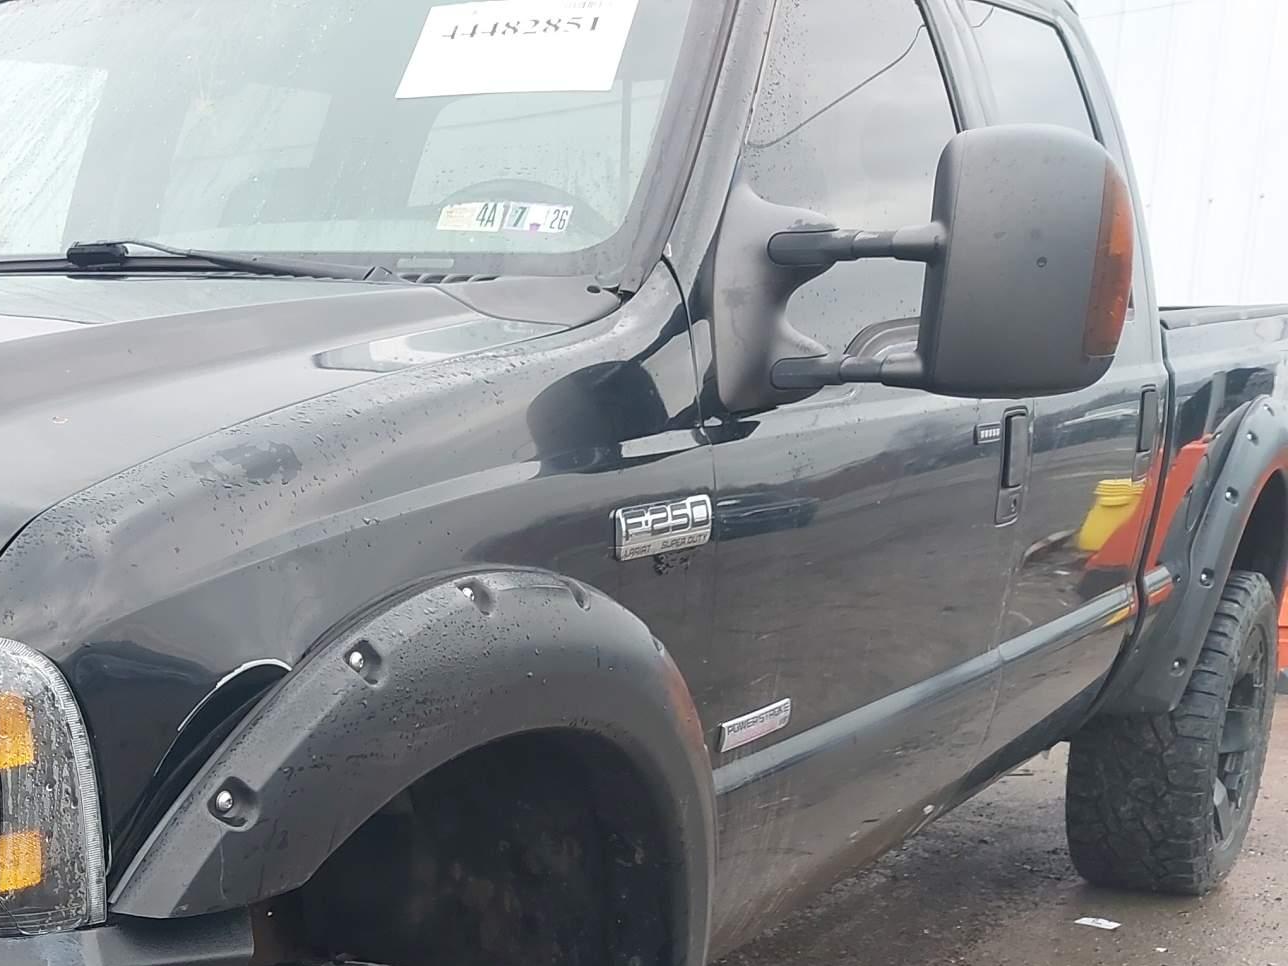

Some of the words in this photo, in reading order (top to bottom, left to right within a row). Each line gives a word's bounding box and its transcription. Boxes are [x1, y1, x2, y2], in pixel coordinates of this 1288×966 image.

[442, 16, 600, 39] 44482851
[476, 203, 498, 227] 4A
[513, 206, 528, 227] 7
[549, 209, 569, 230] 26
[619, 495, 711, 537] F-250
